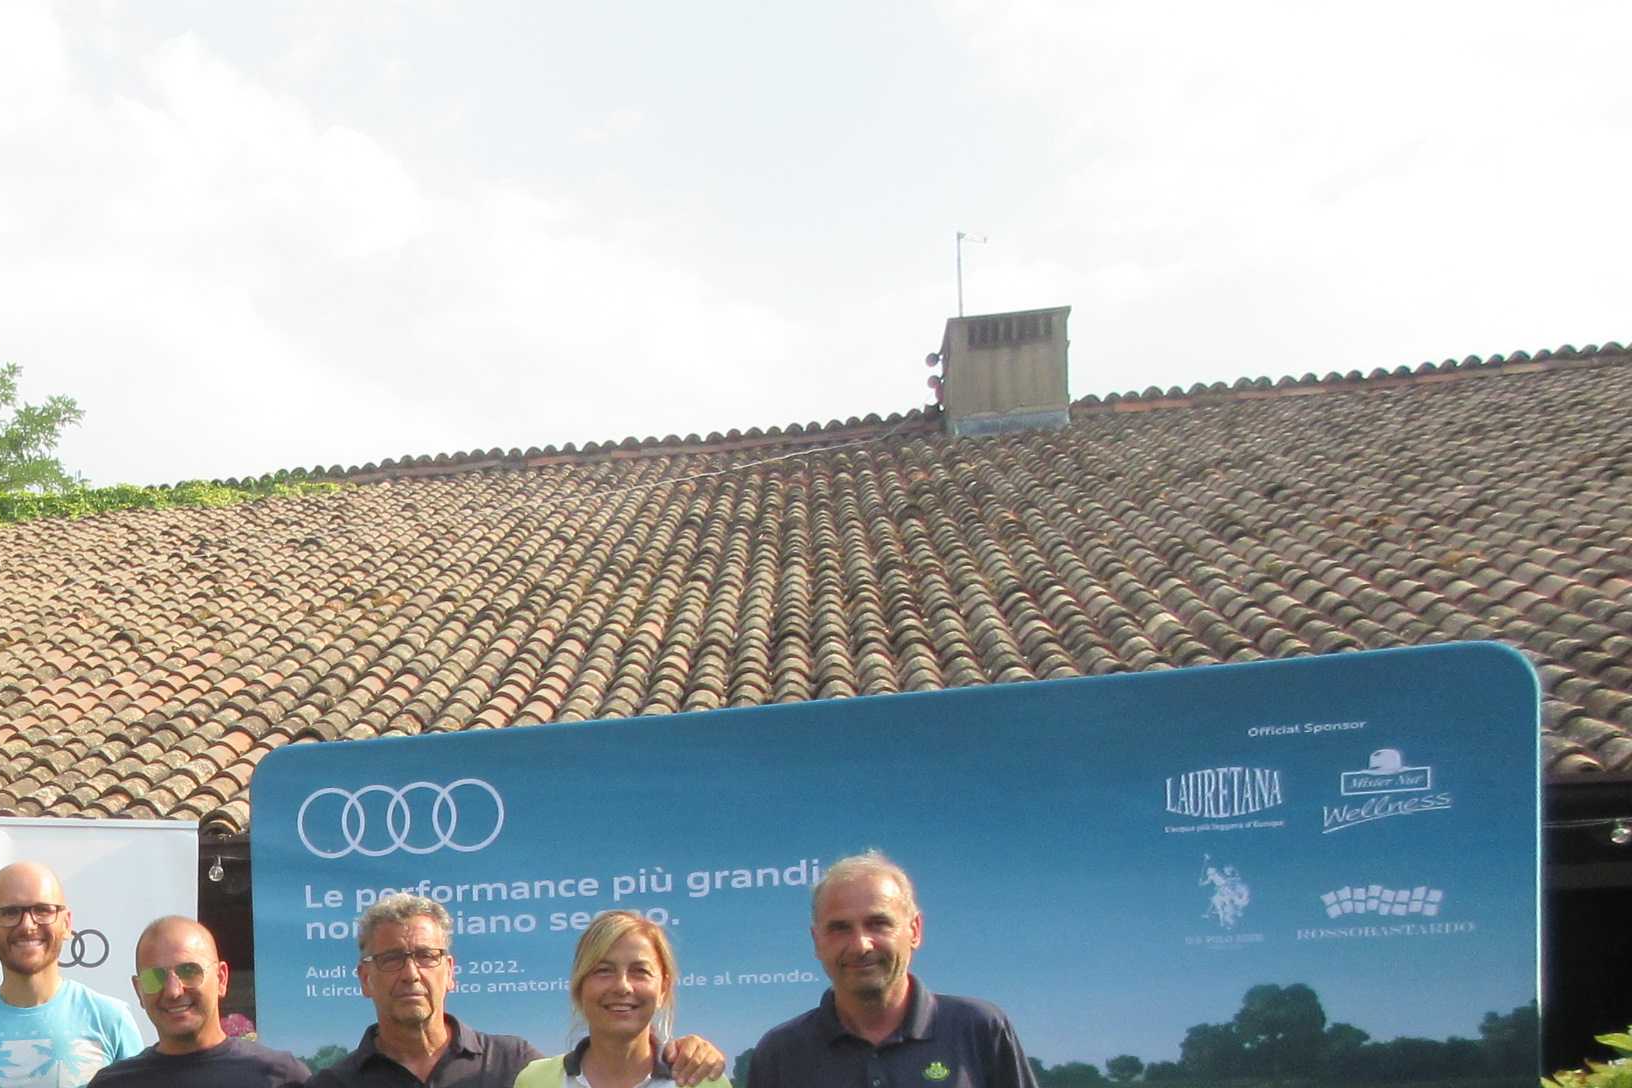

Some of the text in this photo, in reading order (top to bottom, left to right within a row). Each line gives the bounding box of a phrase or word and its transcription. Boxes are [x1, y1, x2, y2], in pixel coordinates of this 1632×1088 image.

[1247, 721, 1367, 737] Official Sponsor
[1165, 766, 1282, 818] LAURETANA
[1322, 792, 1452, 828] Wellness
[304, 884, 344, 908] Le
[612, 866, 673, 901] più
[686, 858, 819, 899] grandi
[548, 907, 680, 932] seo.
[305, 965, 346, 979] Audi
[467, 960, 526, 976] 2022.
[306, 985, 318, 997] Il
[321, 983, 364, 997] circu
[486, 977, 571, 994] amatoria
[712, 970, 732, 986] al
[737, 969, 820, 985] mondo.
